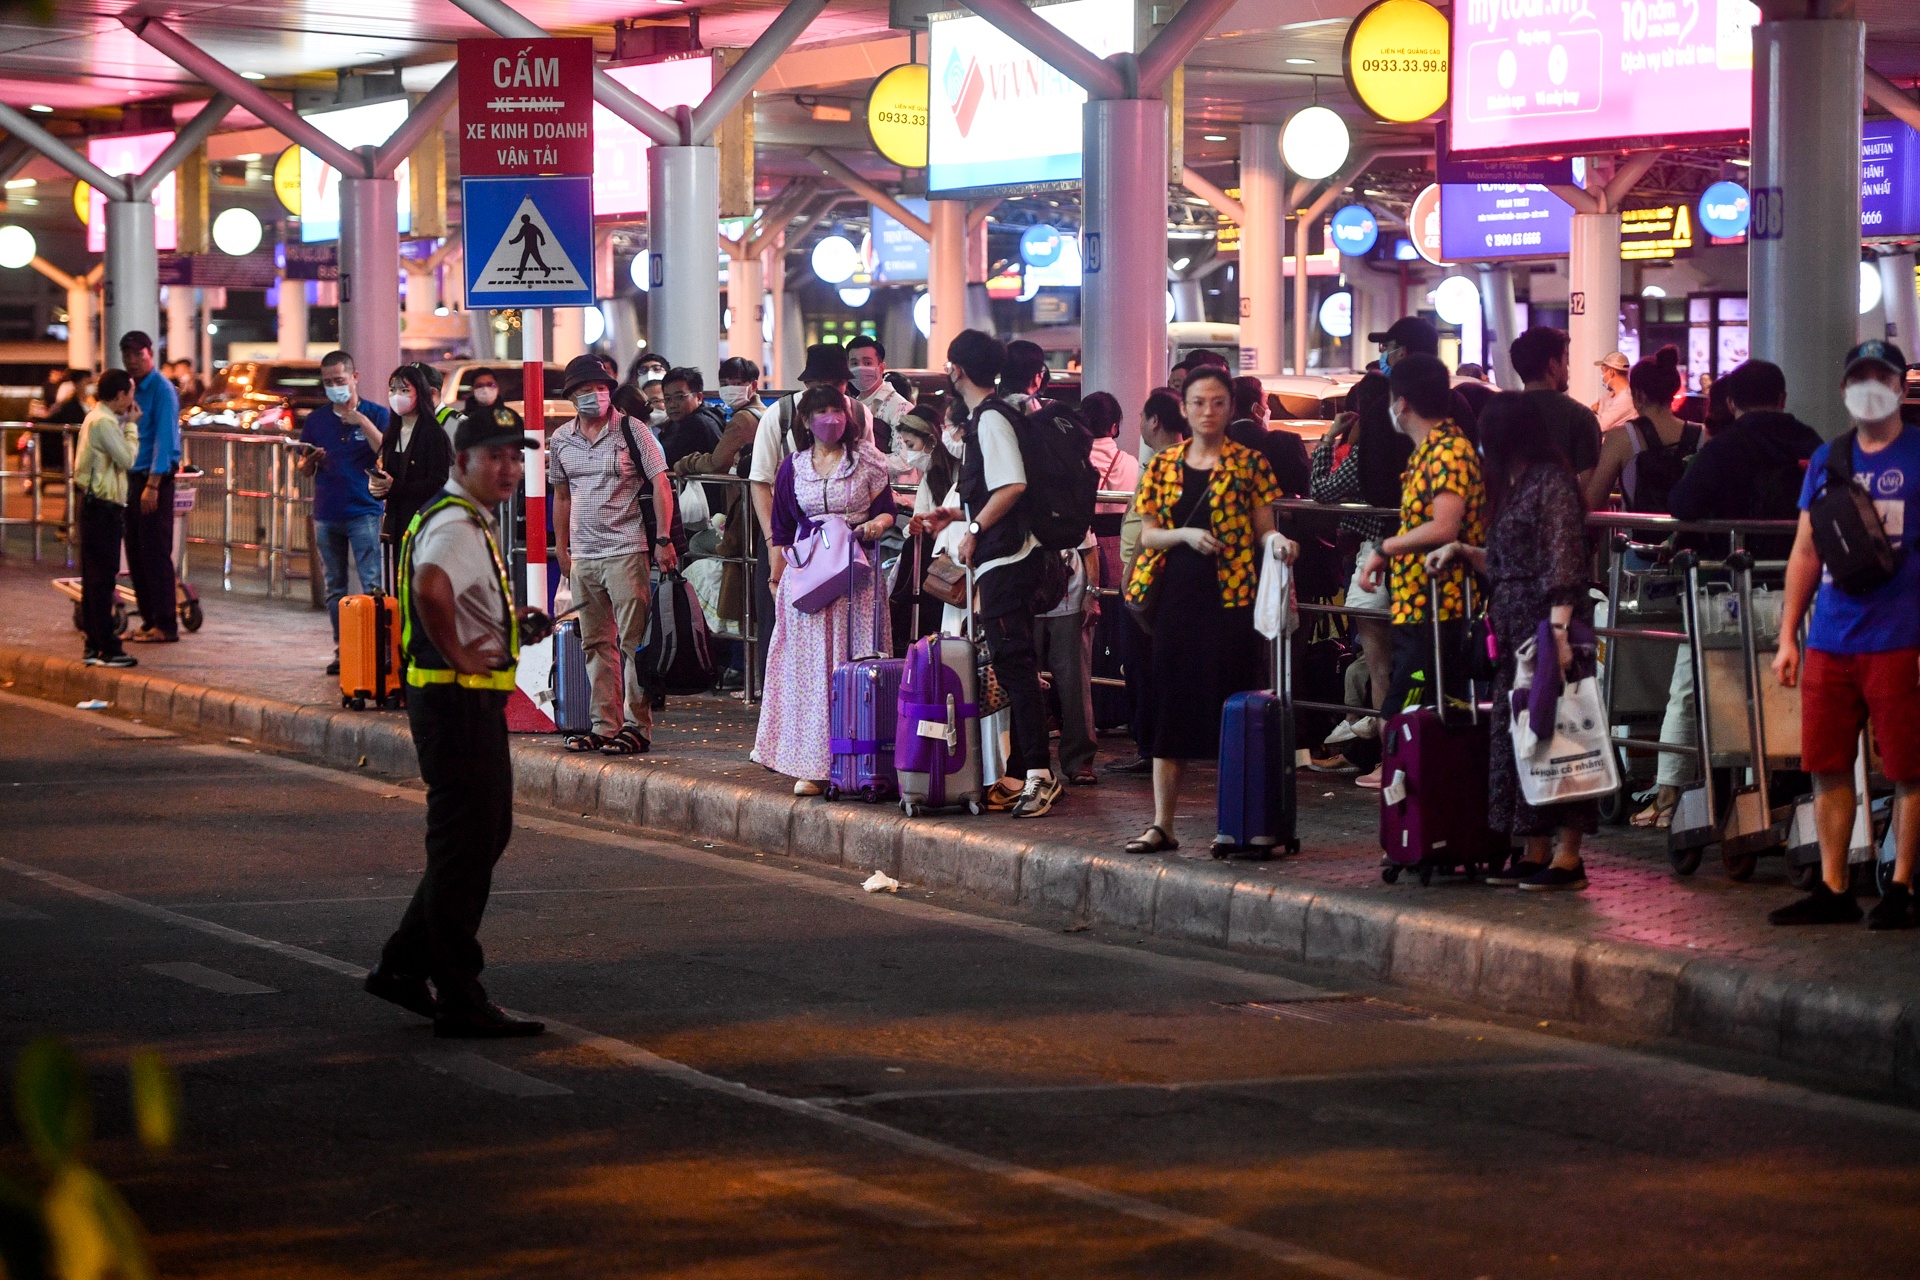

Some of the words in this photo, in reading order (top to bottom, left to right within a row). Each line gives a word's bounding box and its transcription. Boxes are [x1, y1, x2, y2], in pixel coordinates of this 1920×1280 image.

[1621, 0, 1647, 42] 10
[493, 46, 560, 89] CẤM
[494, 96, 514, 113] XE
[466, 123, 486, 139] XE
[491, 123, 528, 139] KINH
[533, 122, 588, 139] DOANH
[497, 146, 529, 169] VẬN
[533, 144, 558, 165] TẢI
[1507, 172, 1512, 180] 3
[1514, 172, 1545, 180] Minutes
[1707, 203, 1738, 220] VIB
[1672, 204, 1692, 239] A
[1336, 224, 1364, 241] VIB
